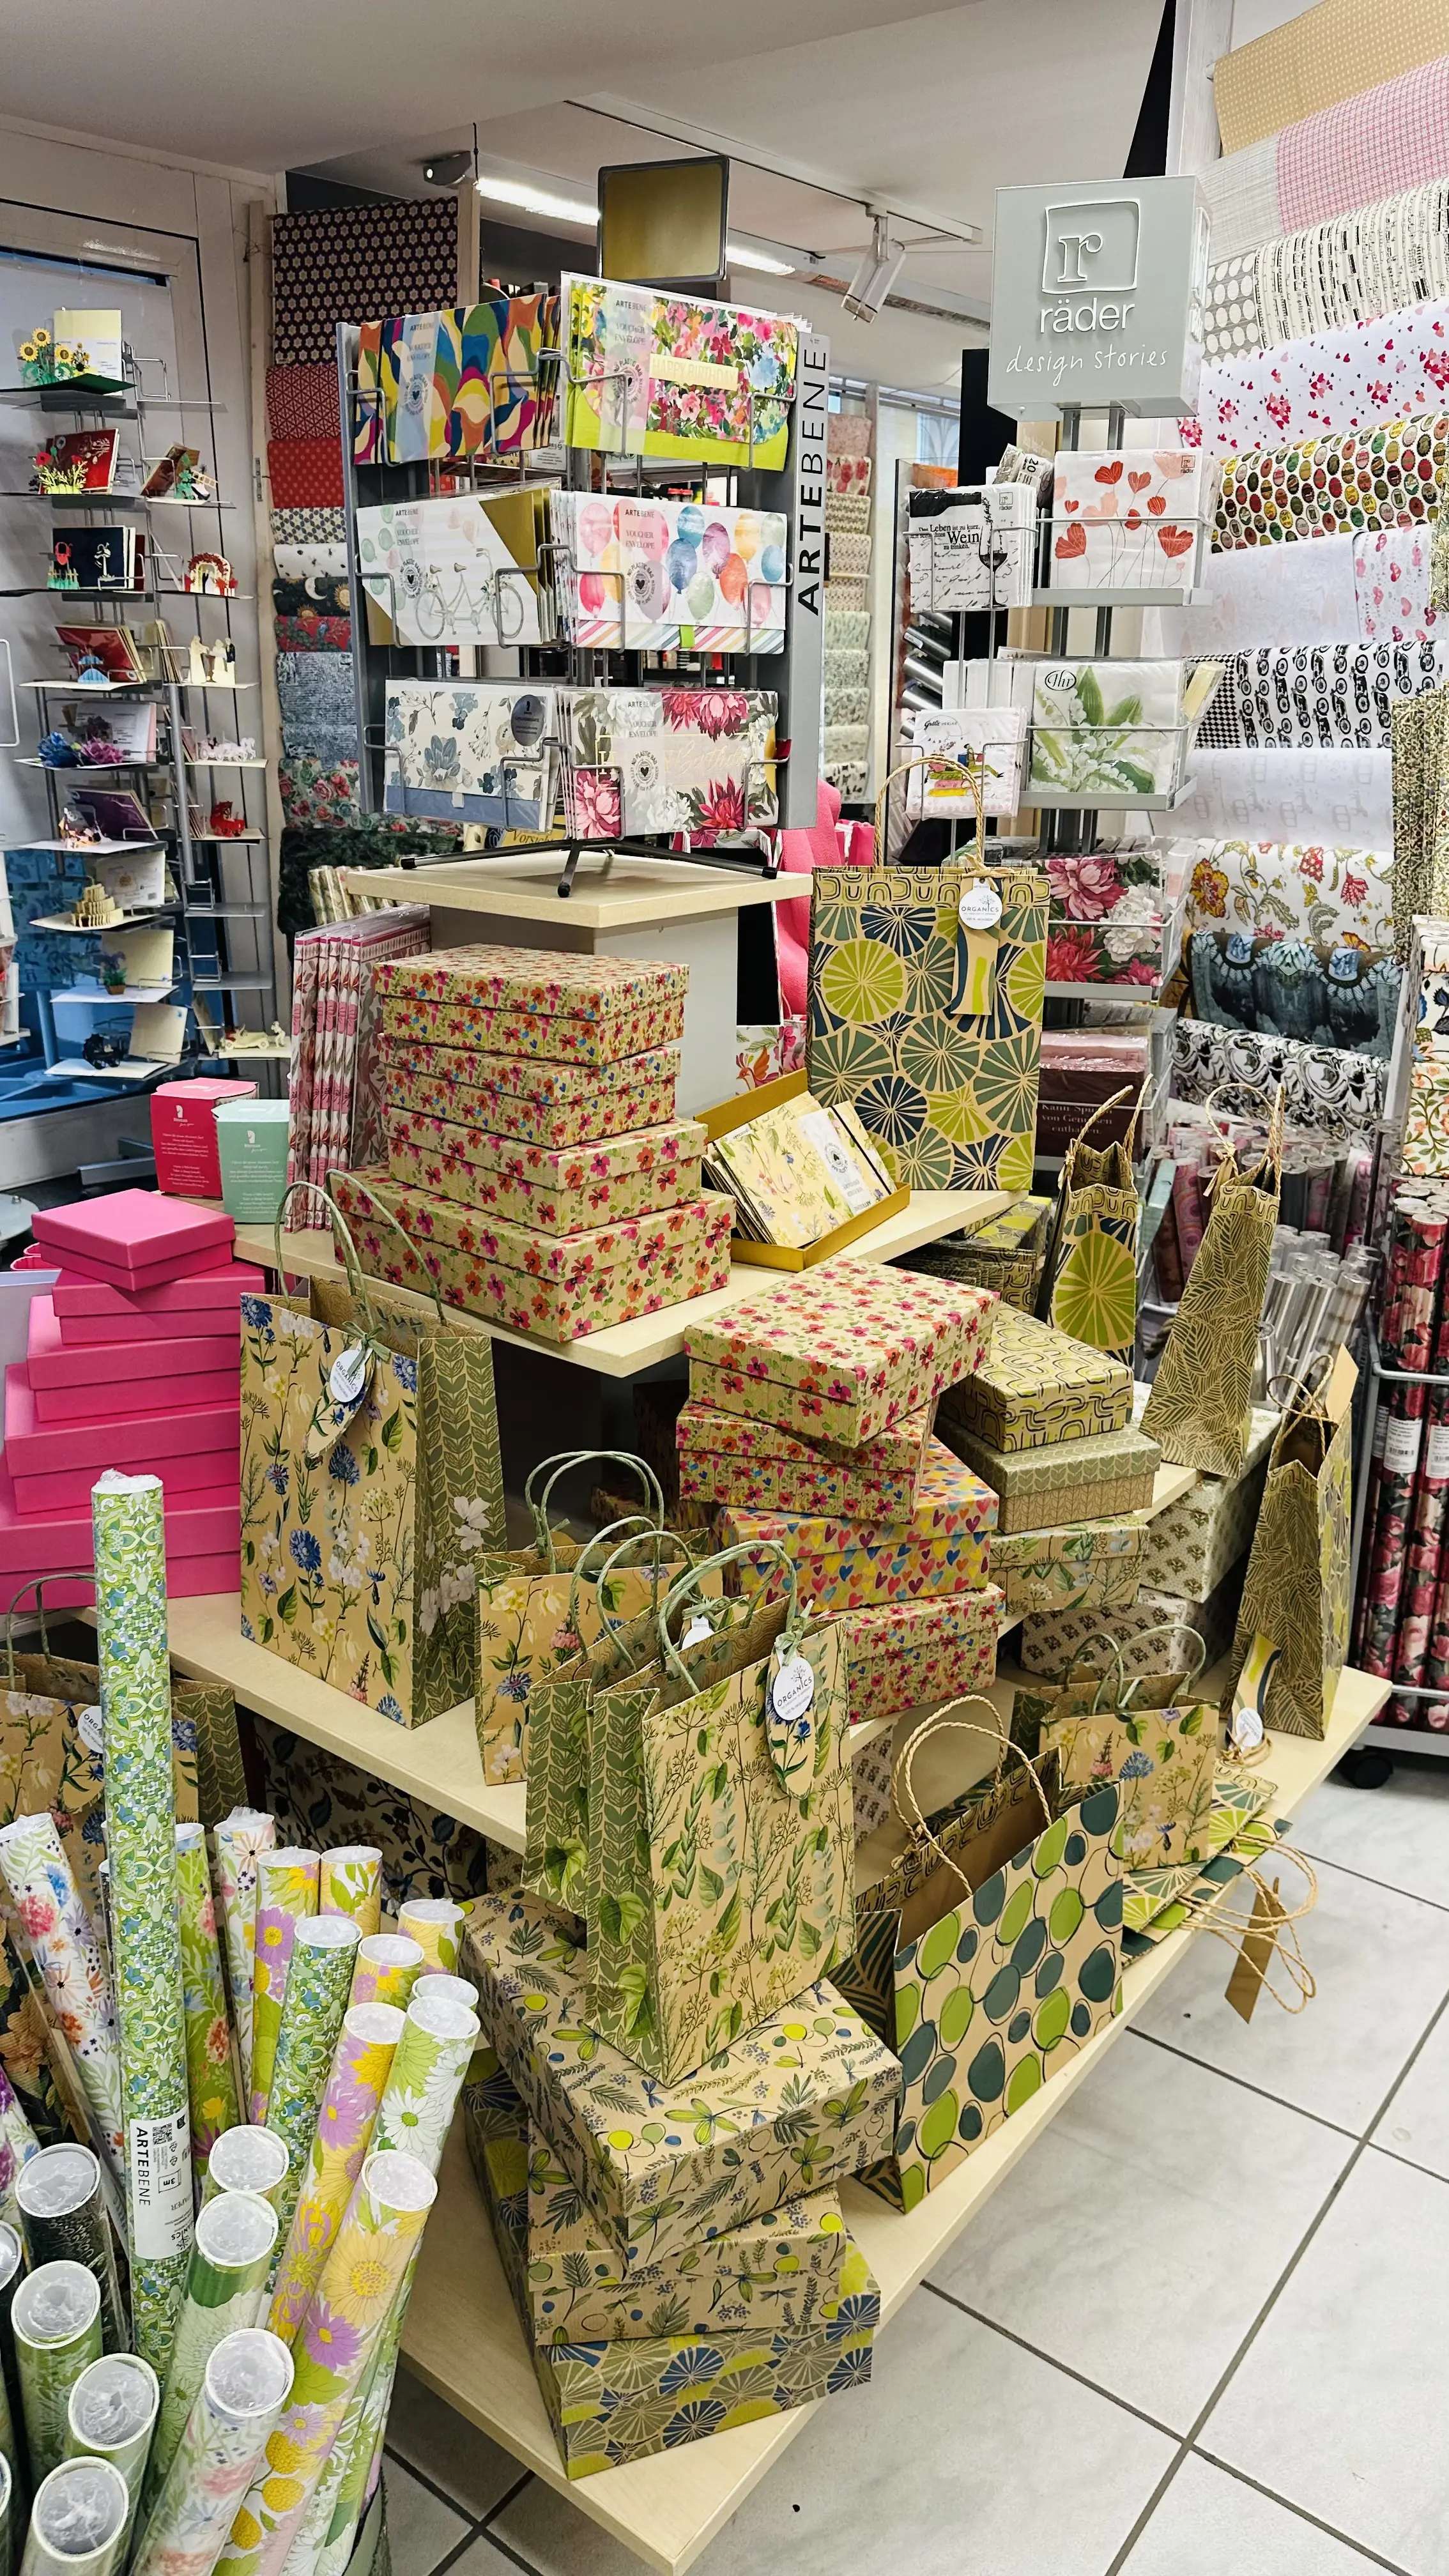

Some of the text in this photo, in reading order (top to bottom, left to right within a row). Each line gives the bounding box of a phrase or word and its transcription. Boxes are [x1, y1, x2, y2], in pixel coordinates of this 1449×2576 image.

[615, 300, 647, 312] ARTEBENE
[1039, 297, 1136, 334] räder
[616, 323, 645, 334] VOUCHER
[615, 334, 646, 345] ENVELOPE
[1006, 343, 1168, 387] design stories
[652, 357, 737, 385] HAPPY BIRTHDAY
[797, 348, 827, 617] ARTEBENE
[625, 509, 655, 518] ARTEBENE
[930, 524, 951, 532] Leben
[625, 530, 654, 539] VOUCHER
[946, 530, 979, 544] Wein
[625, 540, 655, 549] ENVELOPE
[627, 700, 657, 709] ARTEBENE
[635, 750, 651, 760] PLASTIC
[777, 1676, 813, 1707] ORGANICS
[136, 2126, 151, 2206] ARTEBENE
